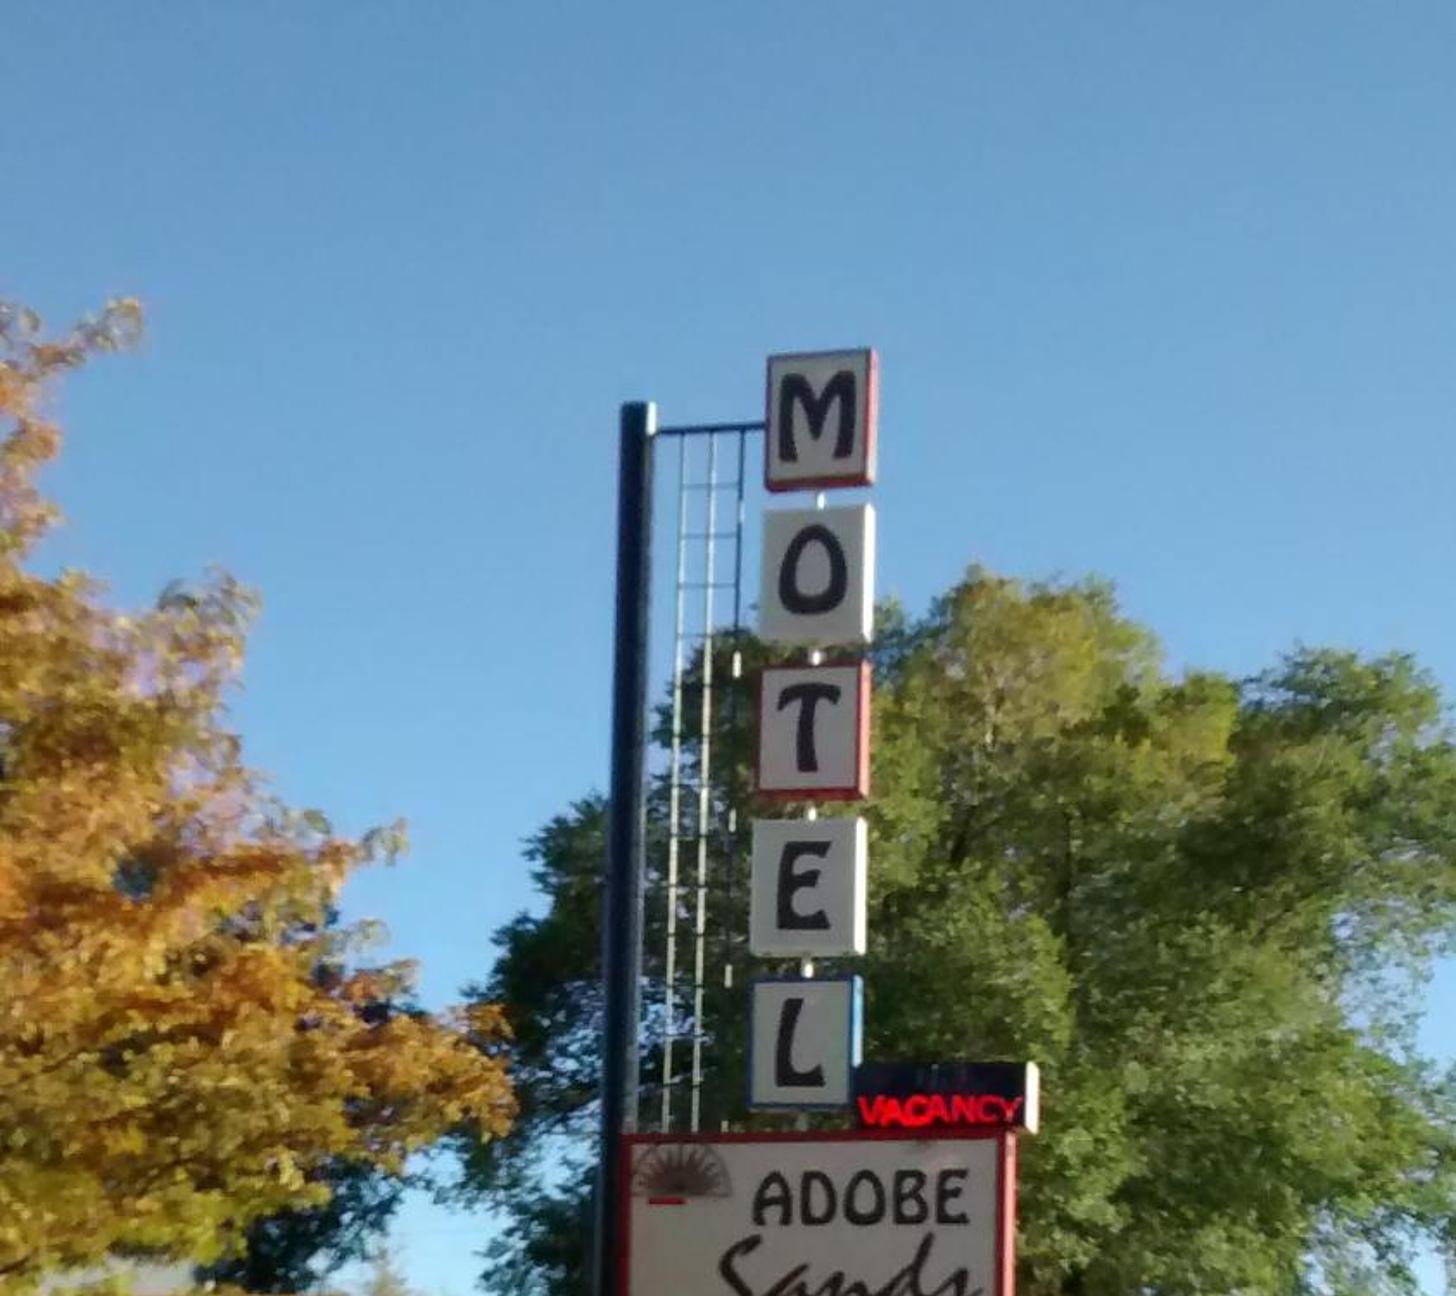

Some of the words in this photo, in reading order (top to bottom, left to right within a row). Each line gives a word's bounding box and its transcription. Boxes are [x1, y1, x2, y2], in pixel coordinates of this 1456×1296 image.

[776, 370, 857, 1088] MOTEL
[857, 1094, 1024, 1127] VACANCY
[752, 1168, 970, 1226] ADOBE
